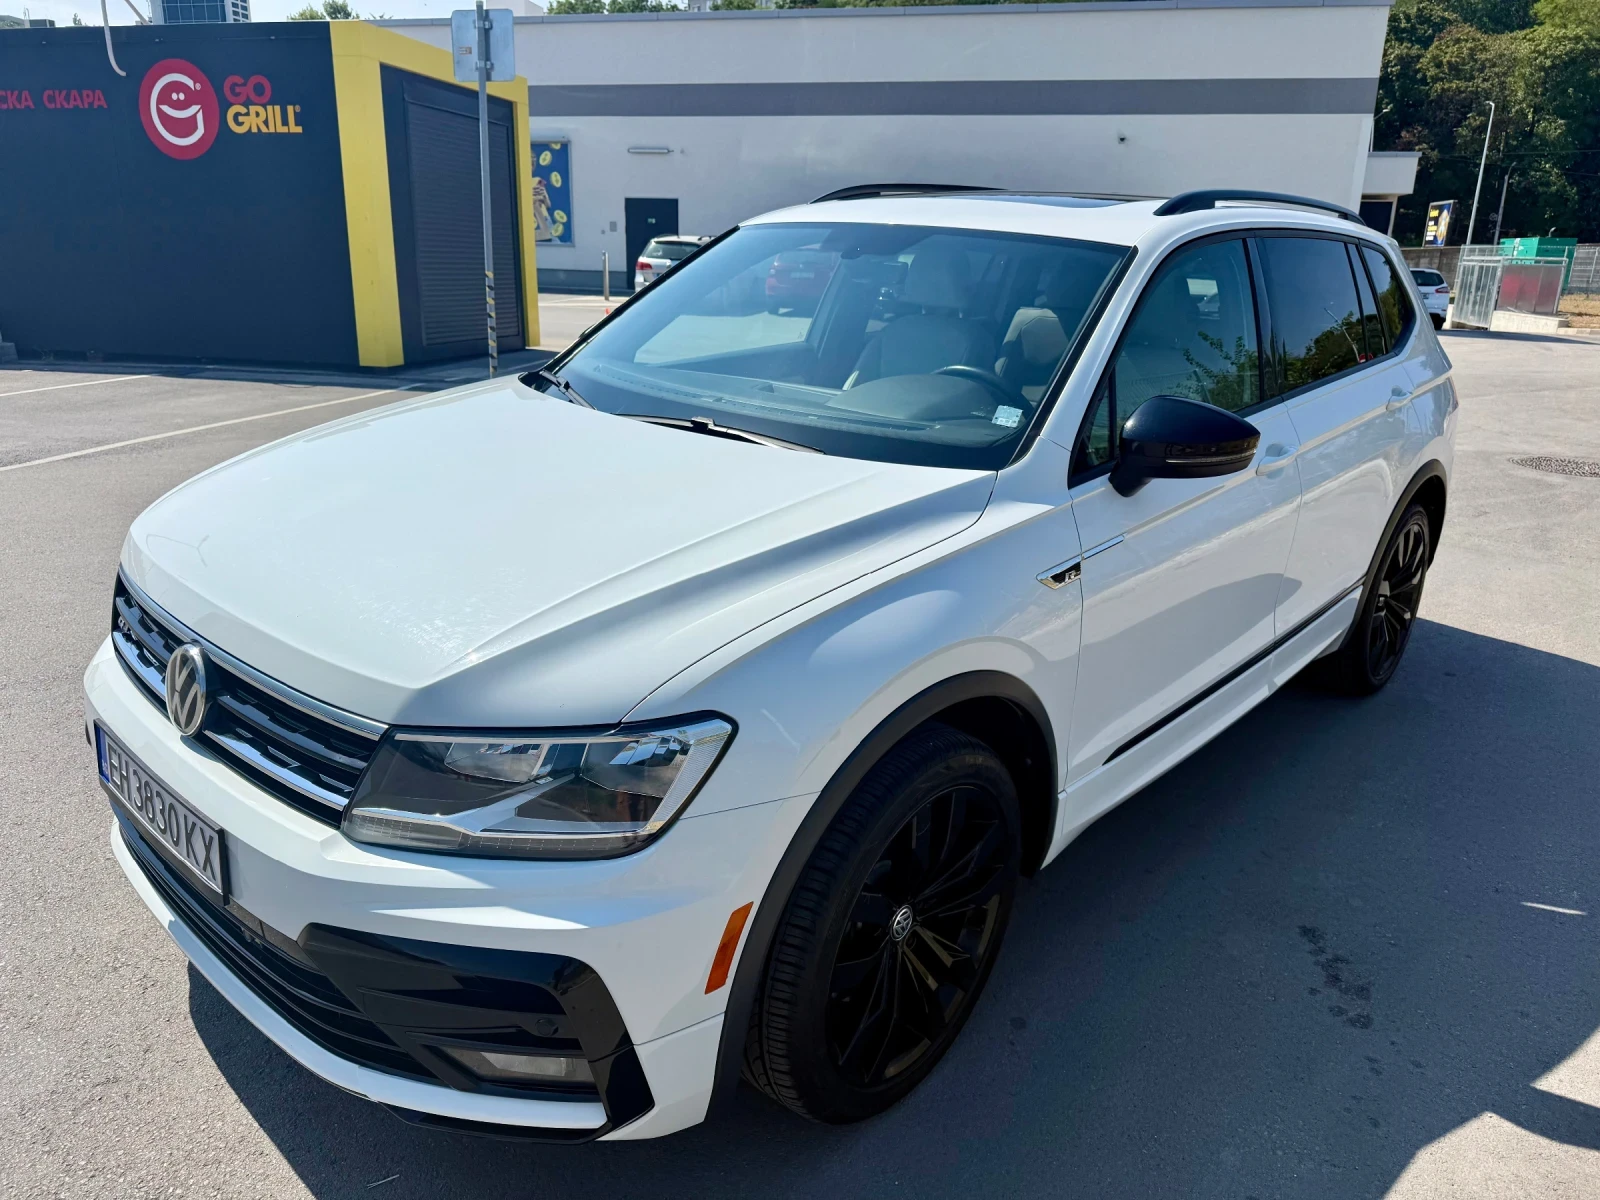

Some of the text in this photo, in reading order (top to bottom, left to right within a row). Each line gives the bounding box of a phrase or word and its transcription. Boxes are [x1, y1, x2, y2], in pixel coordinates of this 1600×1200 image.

[43, 89, 108, 109] СКАРА
[223, 74, 272, 104] GO
[226, 104, 303, 134] GRILL
